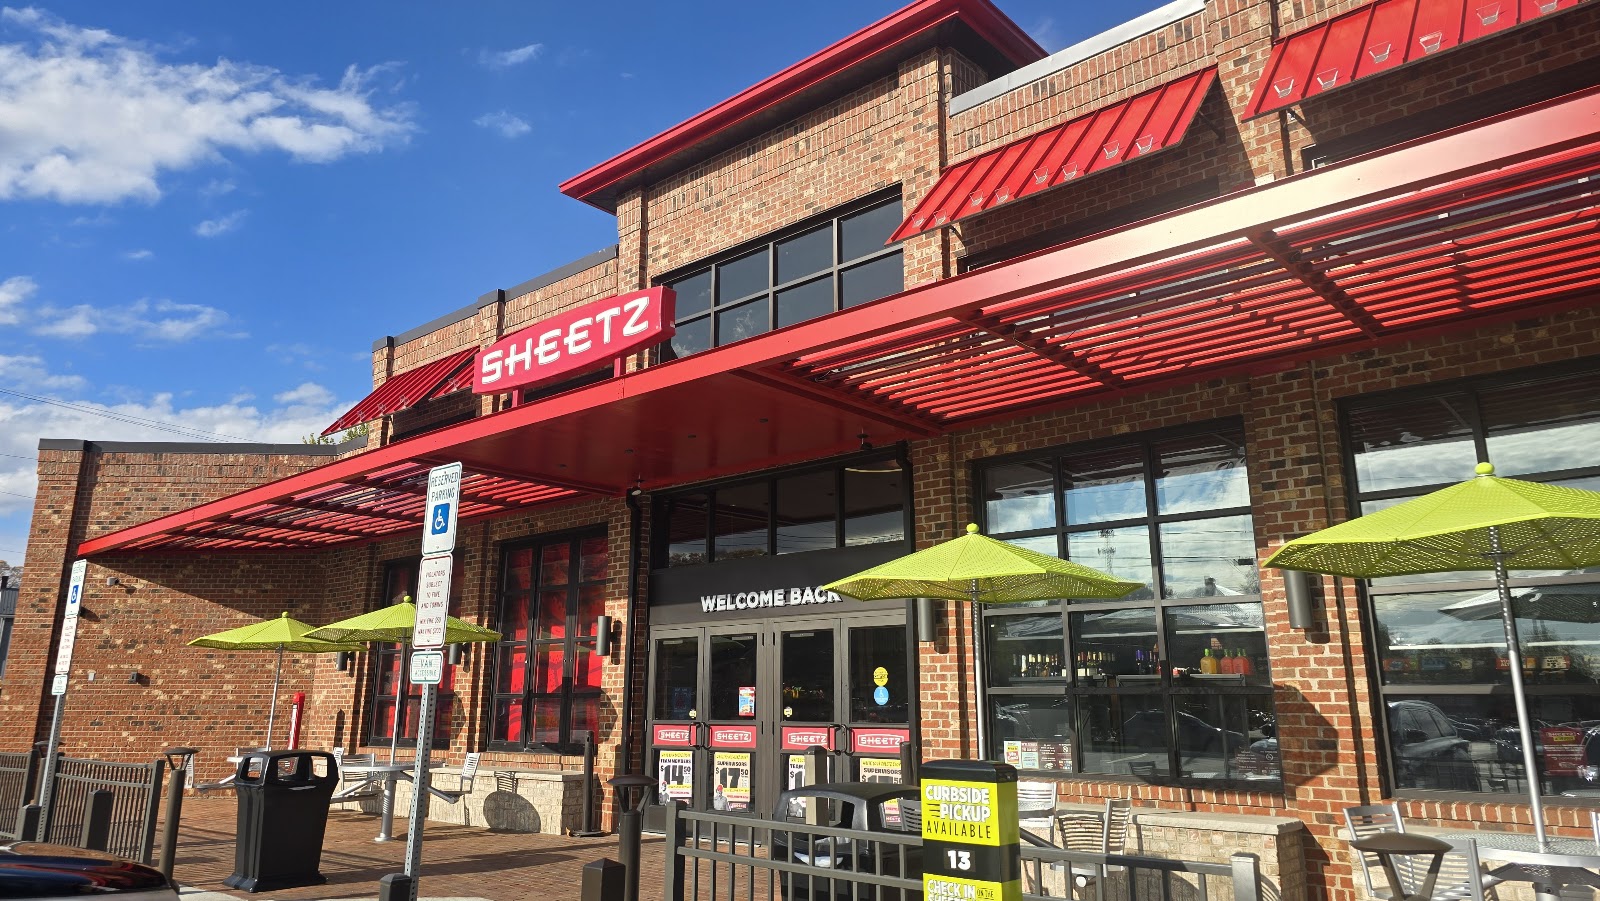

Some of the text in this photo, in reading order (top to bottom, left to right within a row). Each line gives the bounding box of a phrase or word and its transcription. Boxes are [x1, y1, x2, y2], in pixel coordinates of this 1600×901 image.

[482, 296, 650, 384] SHEETZ
[431, 472, 458, 488] RESERVED
[431, 486, 455, 502] PARKING
[426, 570, 446, 578] VIOLATORS
[426, 580, 442, 588] SUBJECT
[701, 585, 843, 612] WELCOME BACK
[420, 659, 432, 668] VAN
[790, 735, 827, 743] SHEETZ
[860, 737, 900, 745] SHEETZ
[715, 767, 740, 788] $17
[925, 784, 990, 804] CURBSIDE
[940, 802, 991, 822] PICKUP
[926, 820, 991, 839] AVAILABLE
[947, 850, 971, 871] 13
[927, 880, 959, 897] CHECK
[963, 884, 976, 899] IN
[976, 888, 984, 897] ON
[985, 889, 993, 898] THE
